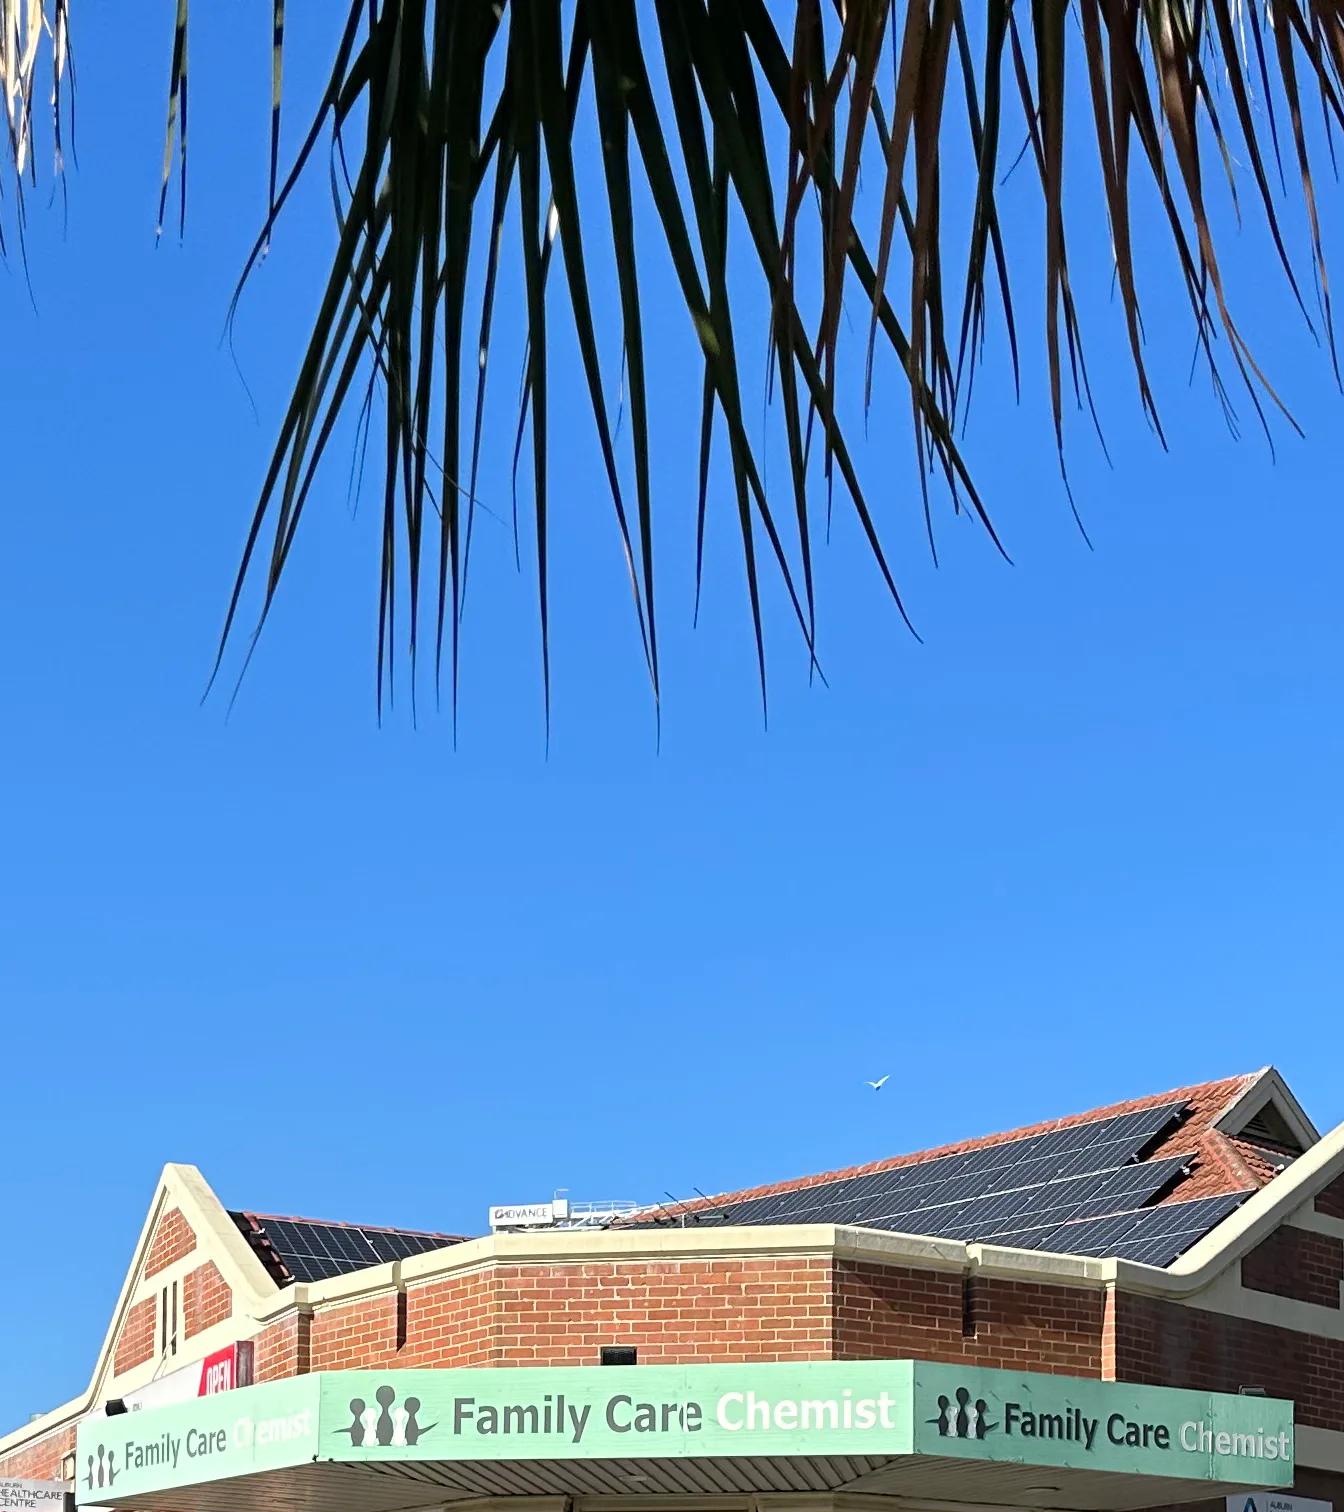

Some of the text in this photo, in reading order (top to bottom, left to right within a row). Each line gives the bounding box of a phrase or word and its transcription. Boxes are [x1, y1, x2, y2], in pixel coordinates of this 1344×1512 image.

[206, 1358, 232, 1396] OPEN
[453, 1388, 897, 1444] Family Care Chemist
[1004, 1403, 1291, 1463] Family Care Chemist
[125, 1433, 181, 1470] Family
[186, 1428, 227, 1457] Care
[1270, 1501, 1293, 1511] AUBURN
